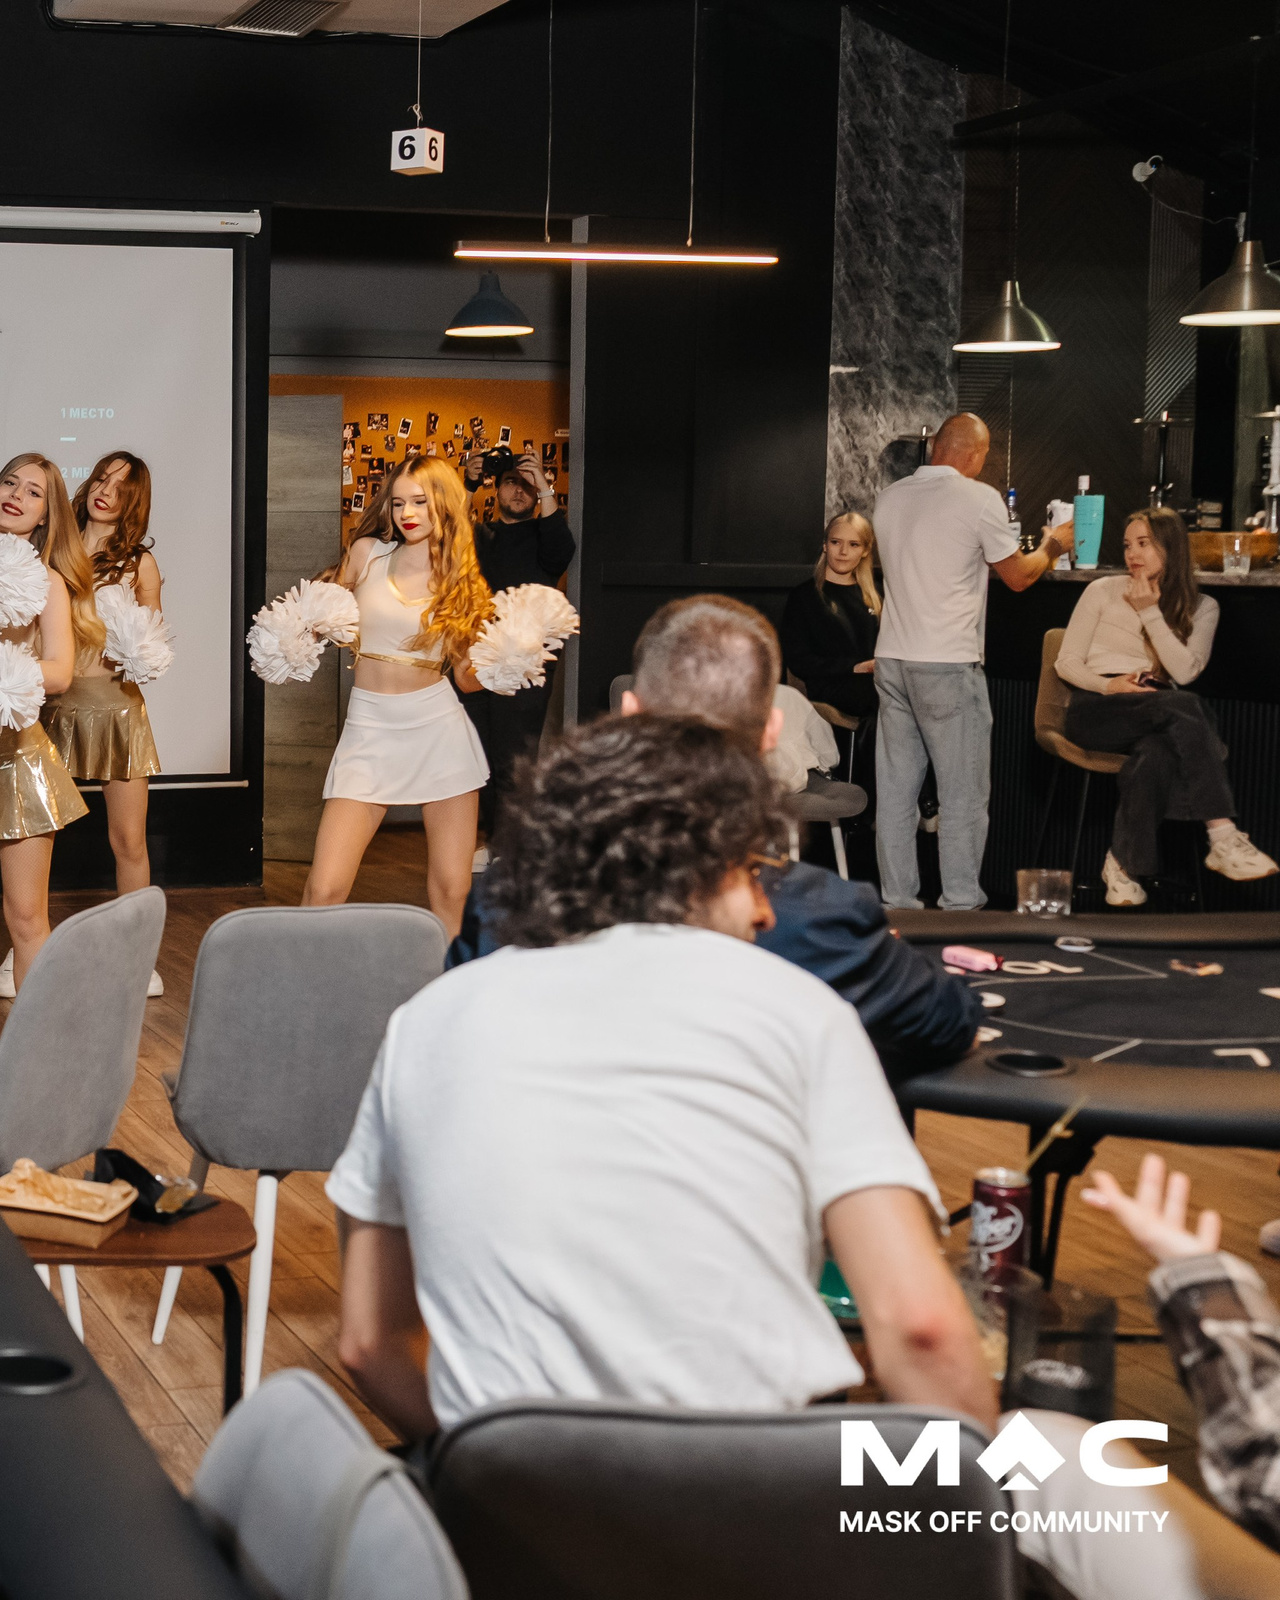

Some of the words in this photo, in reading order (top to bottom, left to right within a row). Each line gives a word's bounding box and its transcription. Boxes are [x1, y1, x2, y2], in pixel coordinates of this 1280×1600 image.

[398, 135, 417, 161] 6
[428, 136, 439, 162] 6
[60, 407, 66, 419] 1
[69, 407, 115, 419] МЕСТО
